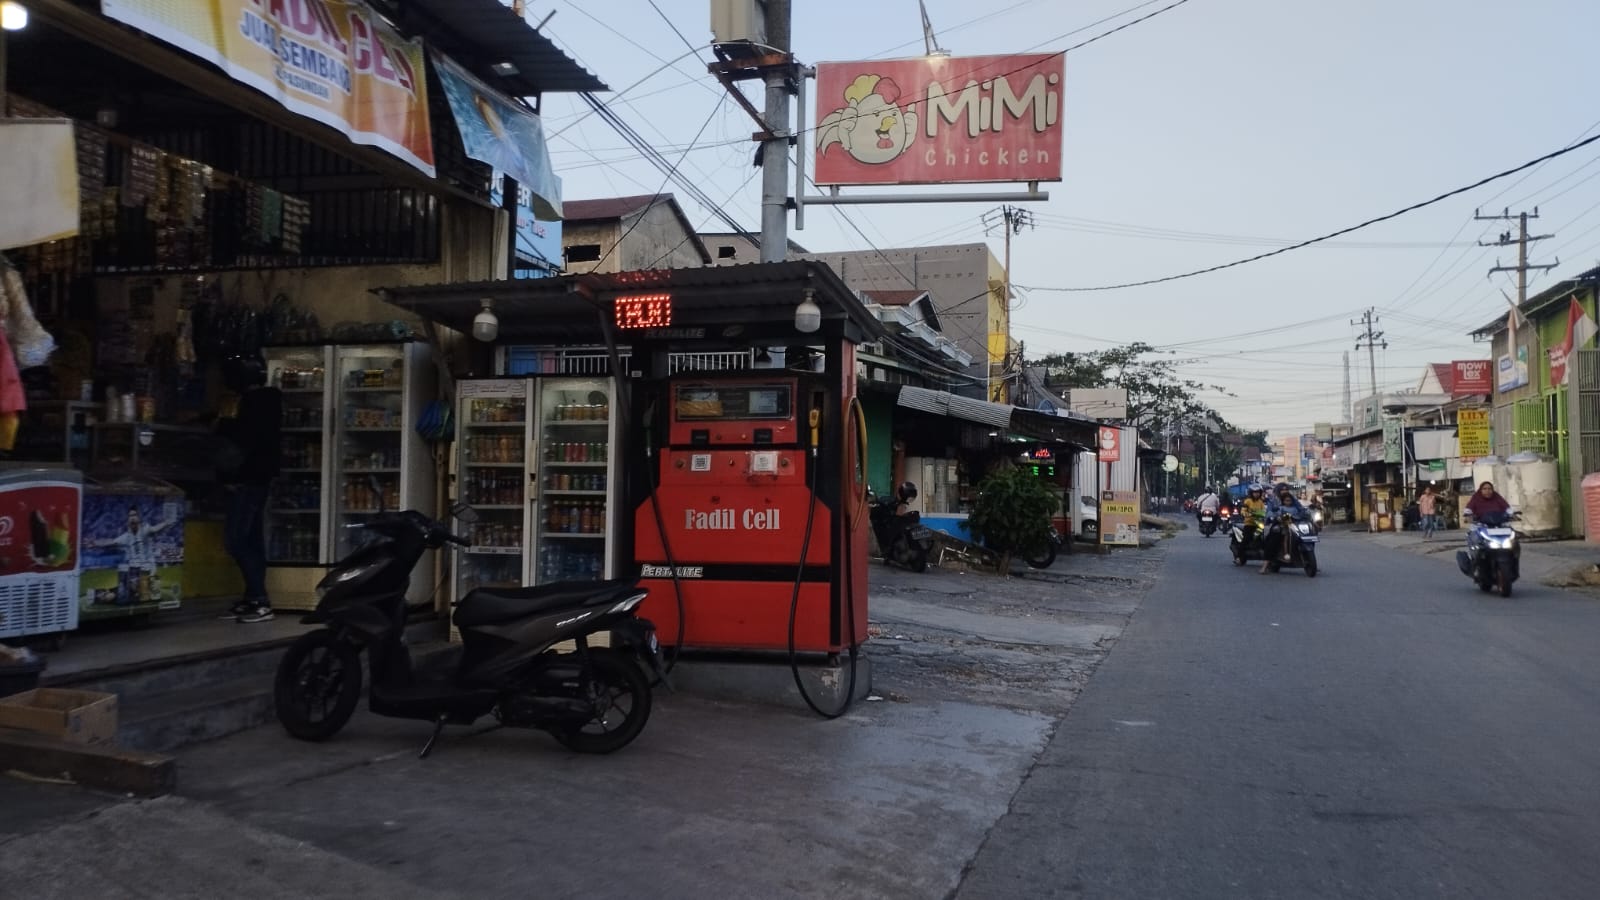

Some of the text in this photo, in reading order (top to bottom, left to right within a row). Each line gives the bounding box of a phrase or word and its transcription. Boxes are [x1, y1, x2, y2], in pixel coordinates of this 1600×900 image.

[240, 11, 279, 55] JUAL
[926, 73, 1059, 138] MiMi
[925, 149, 1049, 166] Chicken
[1461, 411, 1488, 420] LILY
[685, 508, 781, 530] Fadil Cell
